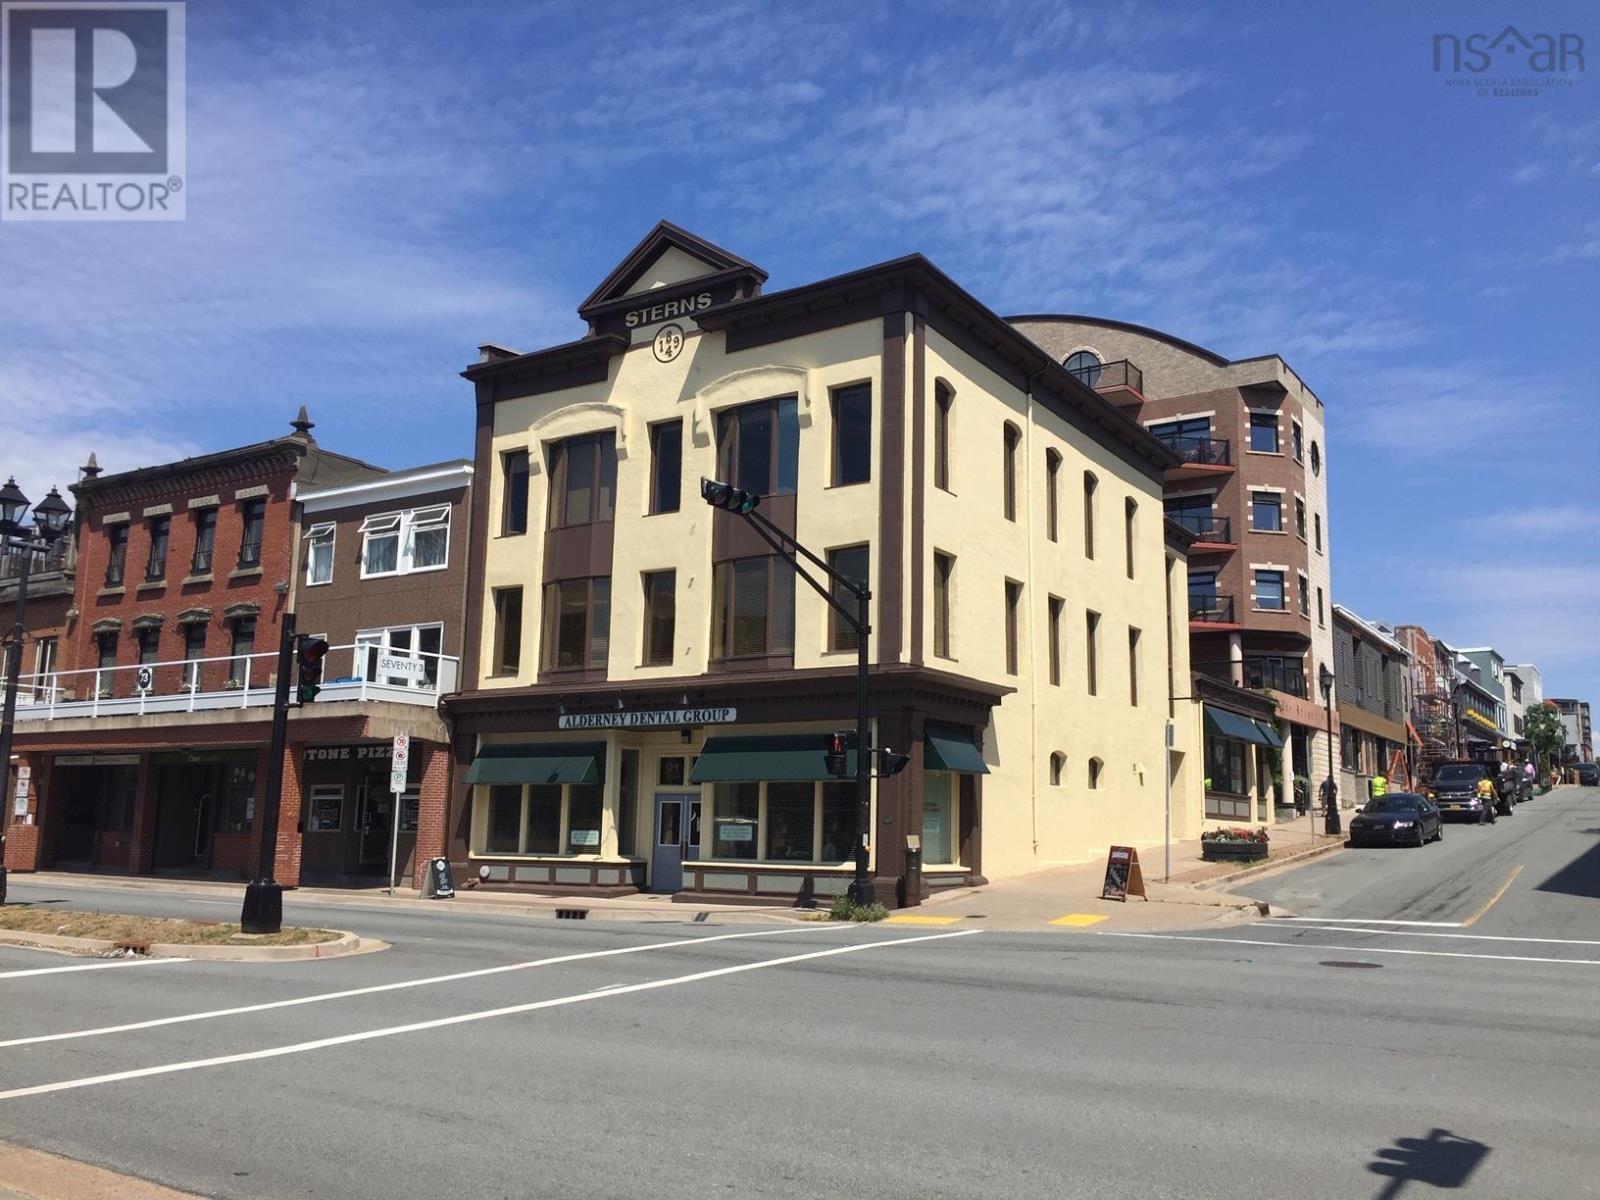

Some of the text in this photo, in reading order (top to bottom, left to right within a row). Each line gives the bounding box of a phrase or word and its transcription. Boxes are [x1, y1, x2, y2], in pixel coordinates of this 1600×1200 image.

[625, 293, 712, 327] STERNS
[381, 659, 424, 672] SEVENTY 3
[565, 708, 729, 728] ALDERNEY DENTAL GROUP
